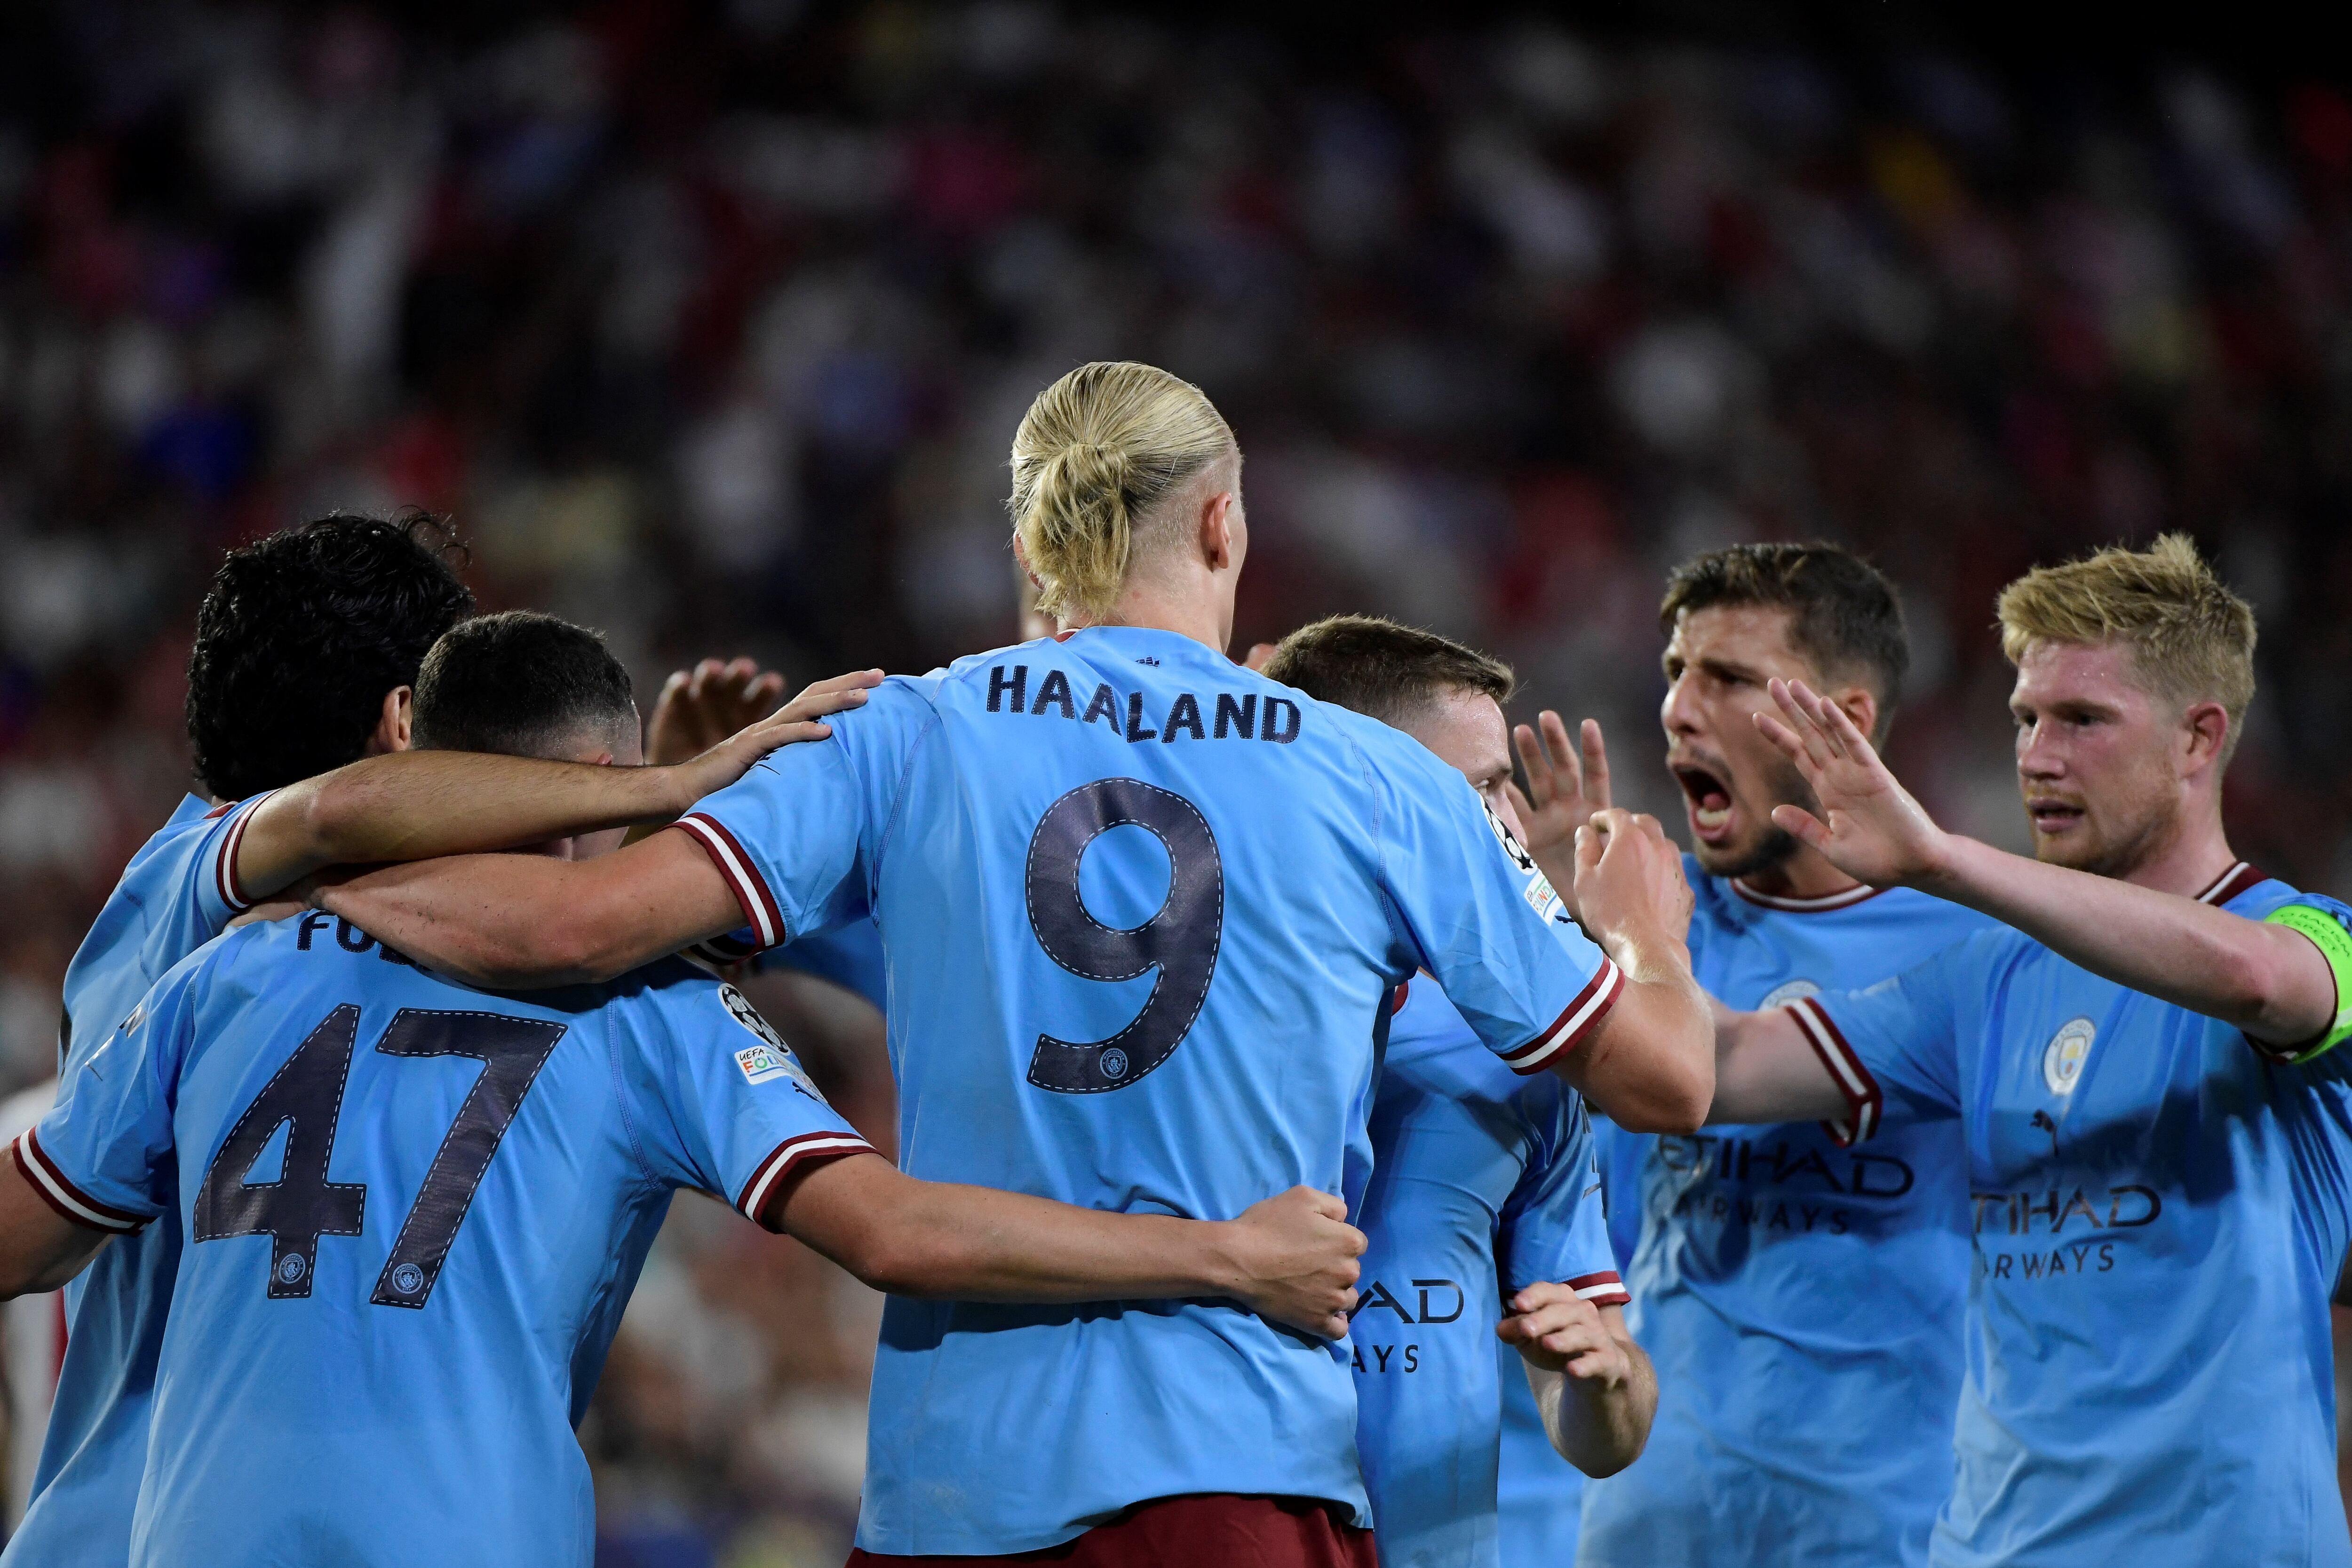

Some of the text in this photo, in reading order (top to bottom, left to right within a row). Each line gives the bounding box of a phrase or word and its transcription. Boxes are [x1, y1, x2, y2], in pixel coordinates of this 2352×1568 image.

[986, 664, 1302, 744] HAALAND
[297, 911, 415, 966] FO
[1025, 776, 1224, 1095] 9
[739, 1048, 765, 1061] UEFA
[1104, 1050, 1125, 1060] MANCHESTER
[193, 1002, 568, 1310] 47
[1659, 1134, 1915, 1198] ETIHAD
[1351, 1344, 1419, 1373] AYS
